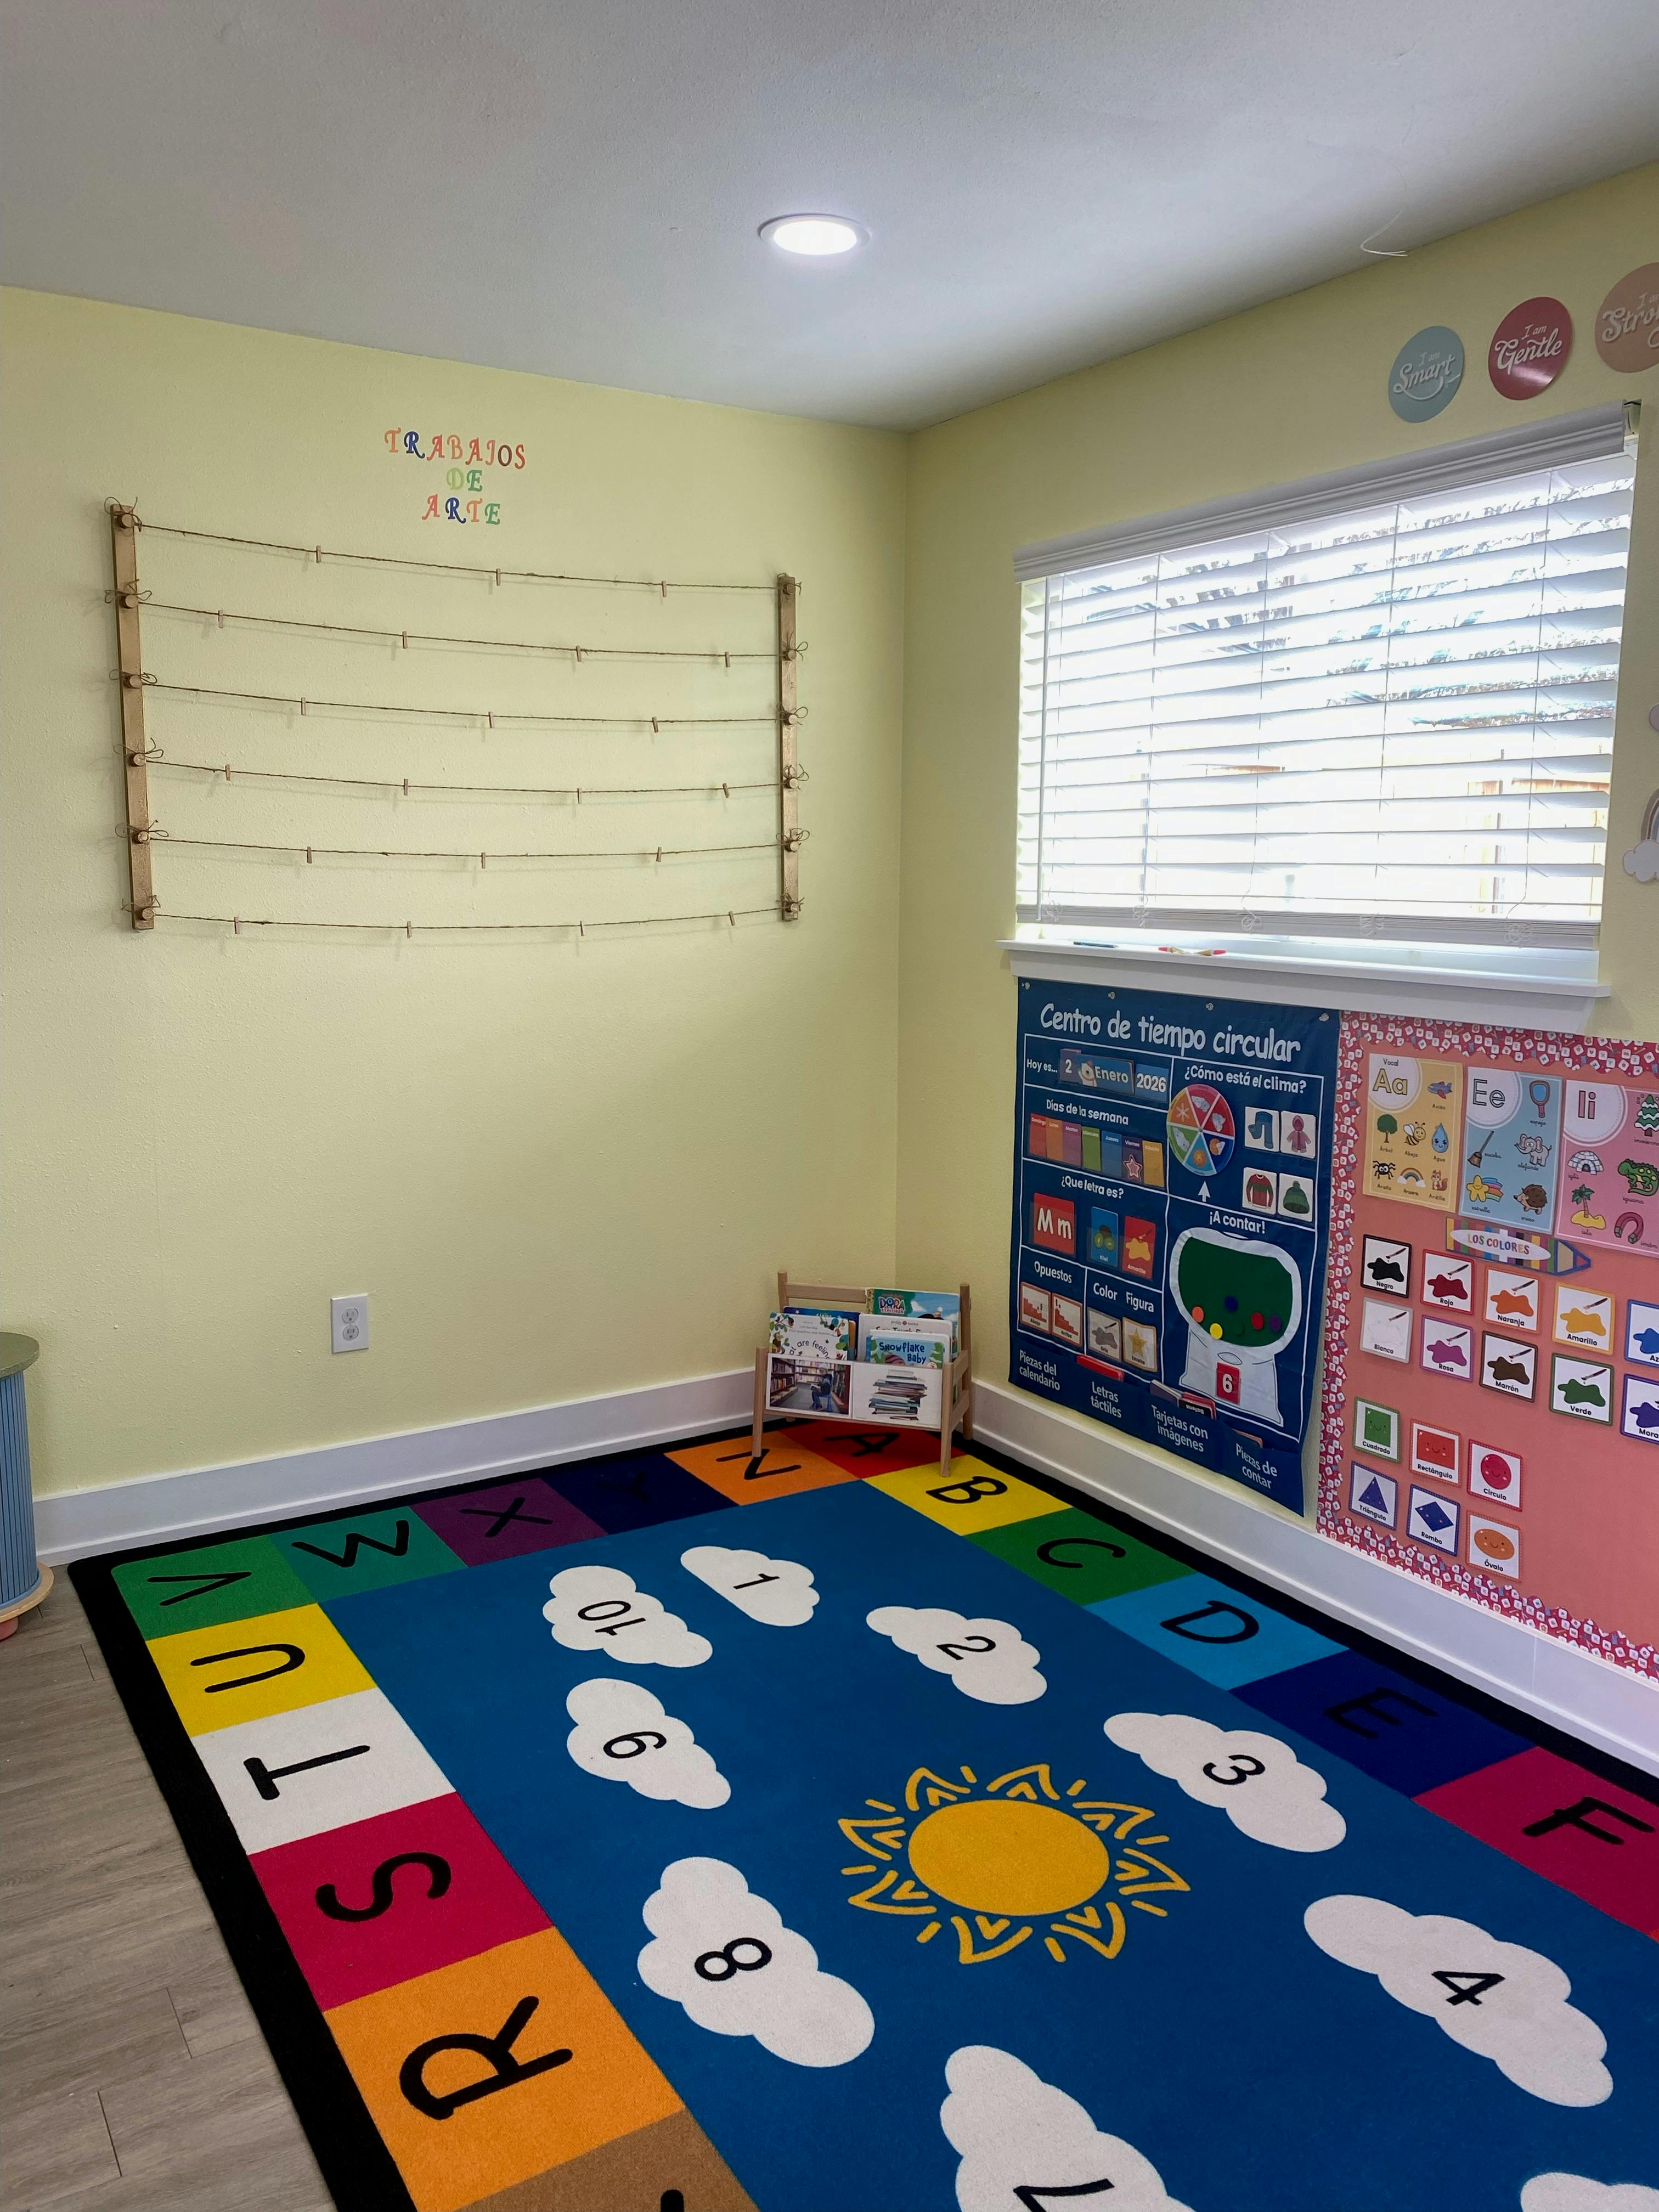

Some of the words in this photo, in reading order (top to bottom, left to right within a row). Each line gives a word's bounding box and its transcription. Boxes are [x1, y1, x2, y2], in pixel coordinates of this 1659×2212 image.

[1521, 324, 1533, 340] I
[1534, 324, 1547, 335] am
[1419, 352, 1426, 365] I
[1495, 328, 1562, 375] Gentle
[1393, 354, 1457, 399] Smart
[384, 427, 525, 469] TRABAJOS
[447, 467, 483, 492] DE
[422, 494, 500, 525] ARTE
[1040, 1003, 1101, 1035] Centro
[1108, 1010, 1131, 1040] de
[1138, 1015, 1206, 1057] tiempo
[1213, 1025, 1301, 1062] circular
[1026, 1058, 1042, 1073] Hoy
[1043, 1063, 1058, 1073] es...
[1065, 1059, 1072, 1074] 2
[1094, 1066, 1128, 1084] Enero
[1136, 1073, 1166, 1092] 2026
[1184, 1064, 1223, 1082] ¿Cómo
[1226, 1071, 1251, 1086] está
[1252, 1074, 1262, 1088] el
[1263, 1076, 1307, 1094] clima?
[1373, 1068, 1408, 1095] Aa
[1473, 1079, 1505, 1108] Ee
[1046, 1099, 1064, 1113] Días
[1066, 1103, 1077, 1115] de
[1079, 1105, 1086, 1118] la
[1088, 1110, 1128, 1125] semana
[1061, 1175, 1083, 1189] ¿Que
[1084, 1180, 1104, 1195] letra
[1107, 1188, 1124, 1199] es?
[1210, 1211, 1221, 1225] ¡A
[1223, 1215, 1265, 1234] contar!
[1468, 1234, 1484, 1244] LOS
[1487, 1239, 1529, 1254] COLORES
[1034, 1261, 1071, 1283] Opuestos
[1093, 1283, 1118, 1301] Color
[1126, 1291, 1154, 1312] Figura
[1376, 1280, 1393, 1290] Negro
[878, 1297, 905, 1311] DORA
[1440, 1298, 1454, 1307] Rojo
[1498, 1314, 1525, 1327] Naranja
[879, 1342, 925, 1353] Snowflake
[1374, 1344, 1394, 1355] Blanco
[1567, 1333, 1598, 1346] Amarillo
[907, 1353, 926, 1364] Baby
[1020, 1350, 1042, 1370] Piezas
[1043, 1362, 1057, 1376] del
[1438, 1363, 1454, 1373] Rosa
[1019, 1365, 1060, 1390] calendario
[1222, 1373, 1233, 1393] 6
[1496, 1381, 1519, 1393] Marrón
[1092, 1381, 1118, 1402] Letras
[1091, 1395, 1121, 1418] táctiles
[1570, 1405, 1592, 1416] Verde
[1152, 1404, 1187, 1431] Tarjetas
[1189, 1423, 1208, 1440] con
[1639, 1428, 1659, 1438] Mora
[825, 1431, 900, 1457] A
[1157, 1421, 1204, 1452] imágenes
[1362, 1441, 1391, 1455] Cuadrado
[715, 1448, 802, 1480] Z
[1236, 1443, 1260, 1471] Piezas
[1262, 1461, 1277, 1477] de
[1418, 1464, 1453, 1480] Rectángulo
[1242, 1465, 1272, 1489] contar
[926, 1476, 1008, 1504] B
[1483, 1488, 1506, 1500] Círculo
[459, 1497, 553, 1537] X
[1359, 1504, 1386, 1521] Triángulo
[291, 1520, 409, 1568] W
[1421, 1531, 1442, 1545] Rombo
[1036, 1538, 1126, 1568] C
[1484, 1560, 1503, 1572] Óvalo
[147, 1571, 252, 1606] V
[733, 1573, 780, 1590] 1
[577, 1600, 646, 1637] 10
[1160, 1600, 1259, 1645] D
[936, 1635, 996, 1660] 2
[190, 1643, 306, 1694] U
[1324, 1686, 1440, 1740] E
[243, 1745, 370, 1800] T
[1203, 1754, 1265, 1786] 3
[1522, 1796, 1658, 1846] F
[315, 1851, 452, 1922] S
[693, 1937, 772, 1982] 8
[1431, 1970, 1505, 2006] 4
[399, 1995, 573, 2120] R
